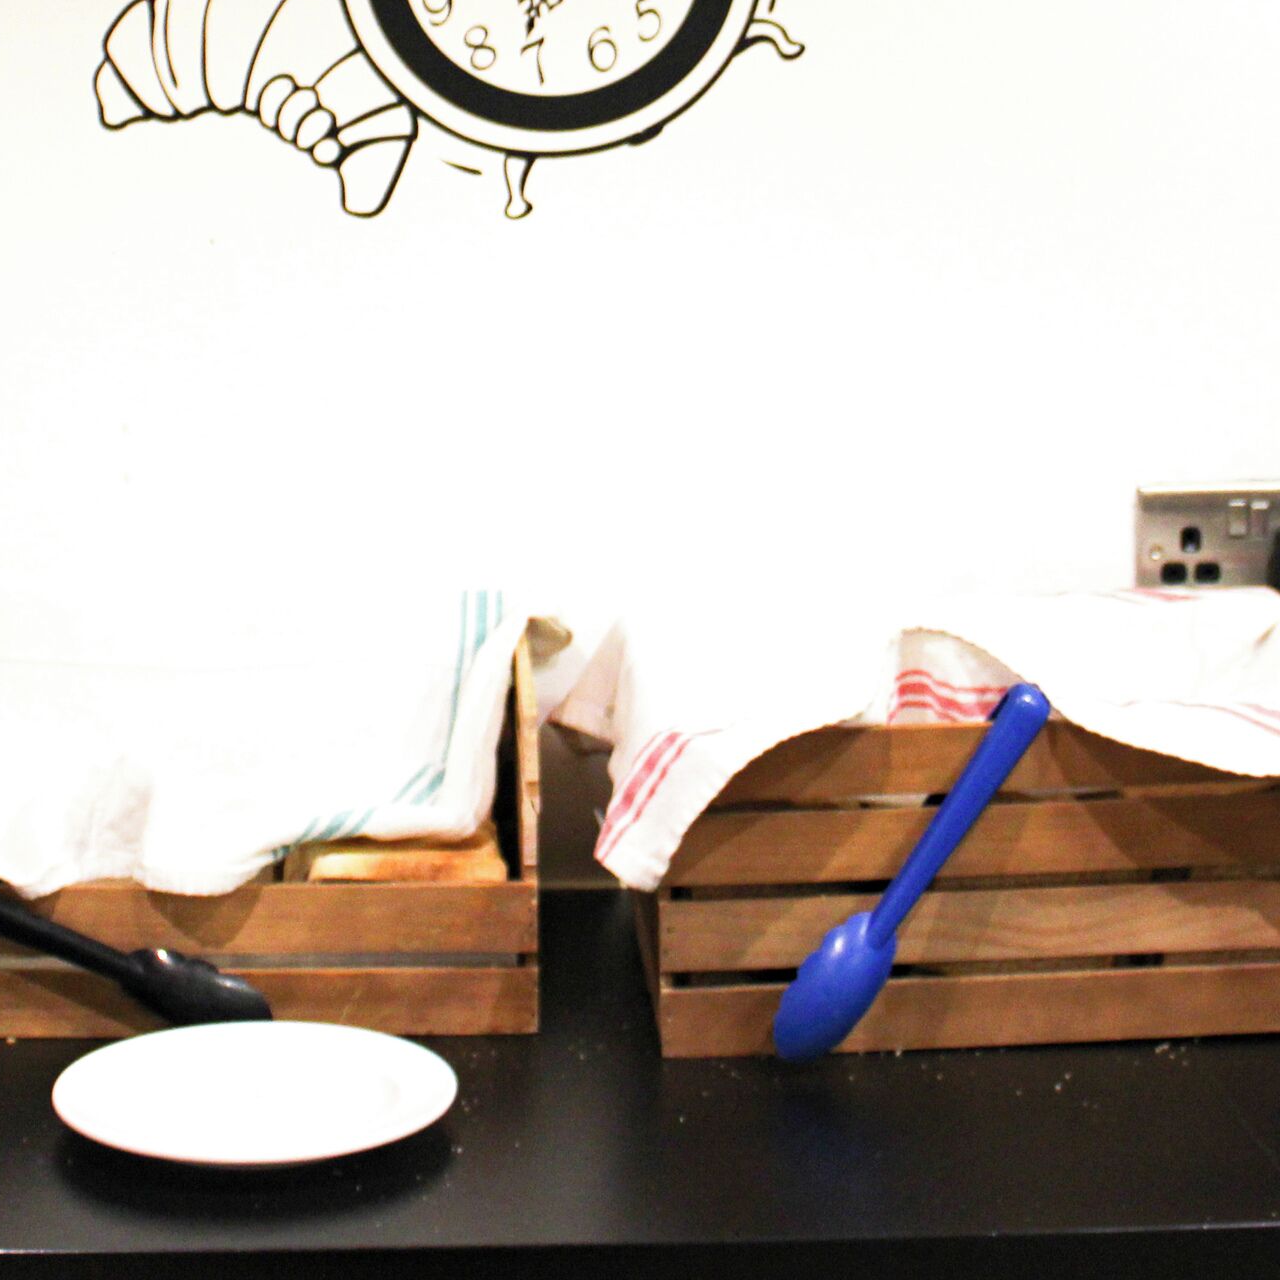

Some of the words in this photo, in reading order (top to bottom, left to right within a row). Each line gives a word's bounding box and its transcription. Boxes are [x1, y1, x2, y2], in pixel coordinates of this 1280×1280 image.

[464, 24, 496, 71] 8
[521, 37, 545, 85] 7
[587, 25, 618, 73] 6
